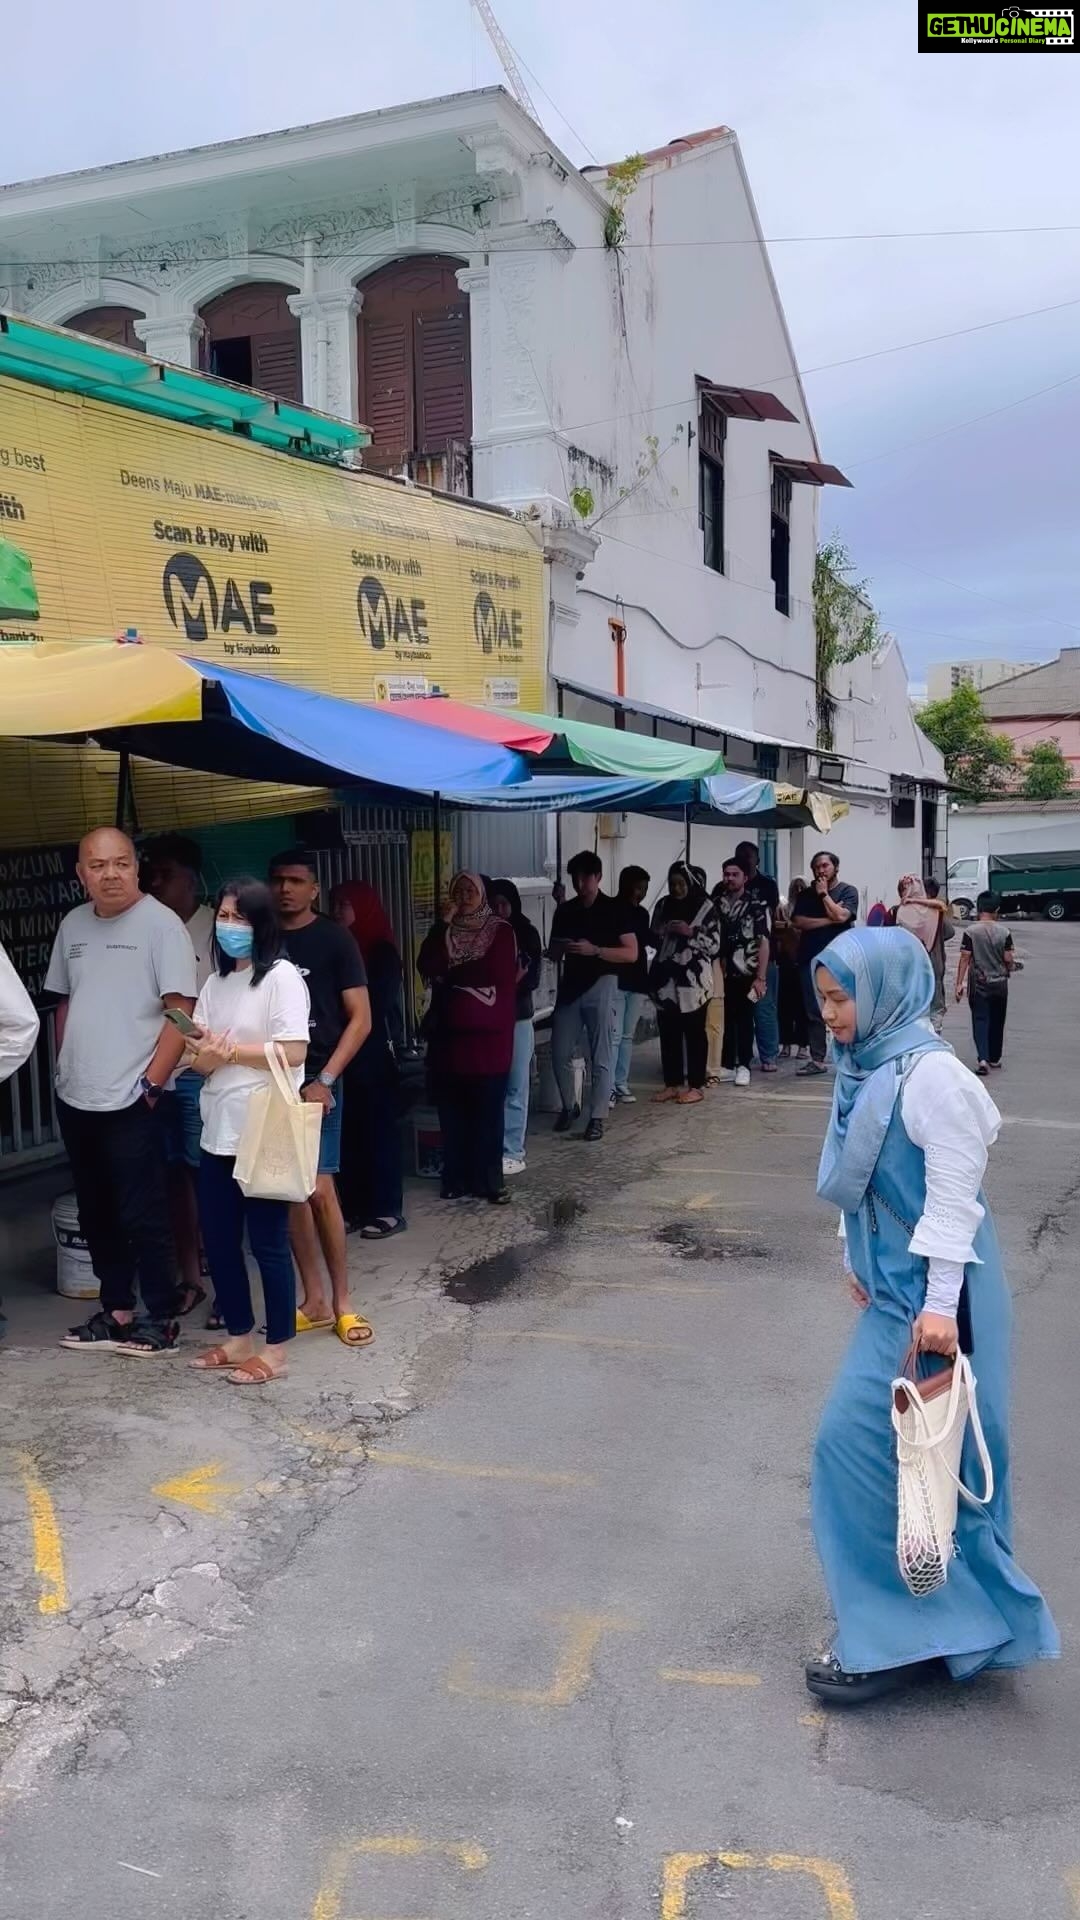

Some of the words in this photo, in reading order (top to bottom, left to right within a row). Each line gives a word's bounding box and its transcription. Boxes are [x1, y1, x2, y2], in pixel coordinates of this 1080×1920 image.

[13, 448, 46, 472] best
[120, 469, 160, 492] Deens
[163, 477, 192, 498] Maju
[153, 519, 192, 544] Scan
[195, 525, 206, 546] &
[208, 527, 235, 553] Pay
[238, 531, 269, 554] with
[351, 549, 375, 569] Scan
[376, 554, 383, 570] &
[384, 555, 402, 577] Pay
[403, 558, 422, 577] with
[163, 551, 278, 641] MAE
[357, 576, 430, 650] MAE
[473, 591, 523, 654] MAE
[223, 641, 235, 655] by
